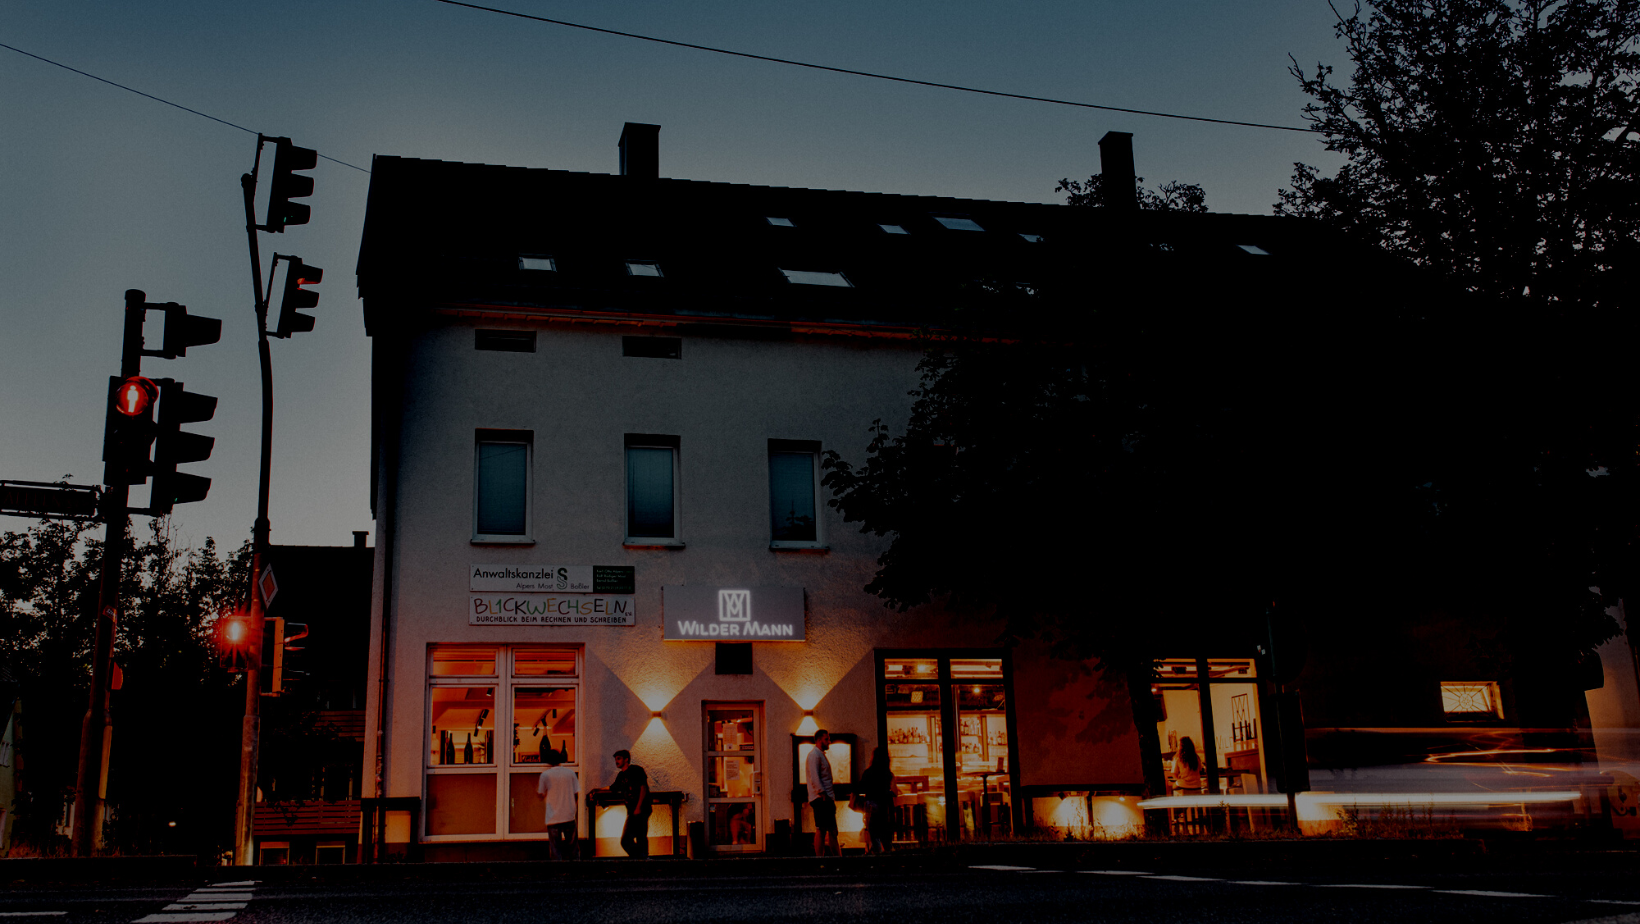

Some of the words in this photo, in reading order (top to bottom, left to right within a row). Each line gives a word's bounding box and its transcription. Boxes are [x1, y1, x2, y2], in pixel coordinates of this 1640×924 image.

[473, 567, 554, 579] Anwaltskanzlei
[516, 582, 535, 590] Alpers
[538, 582, 553, 590] Most
[590, 616, 627, 624] SCHREIBEN
[677, 620, 740, 636] WILDER
[743, 621, 794, 636] MANN
